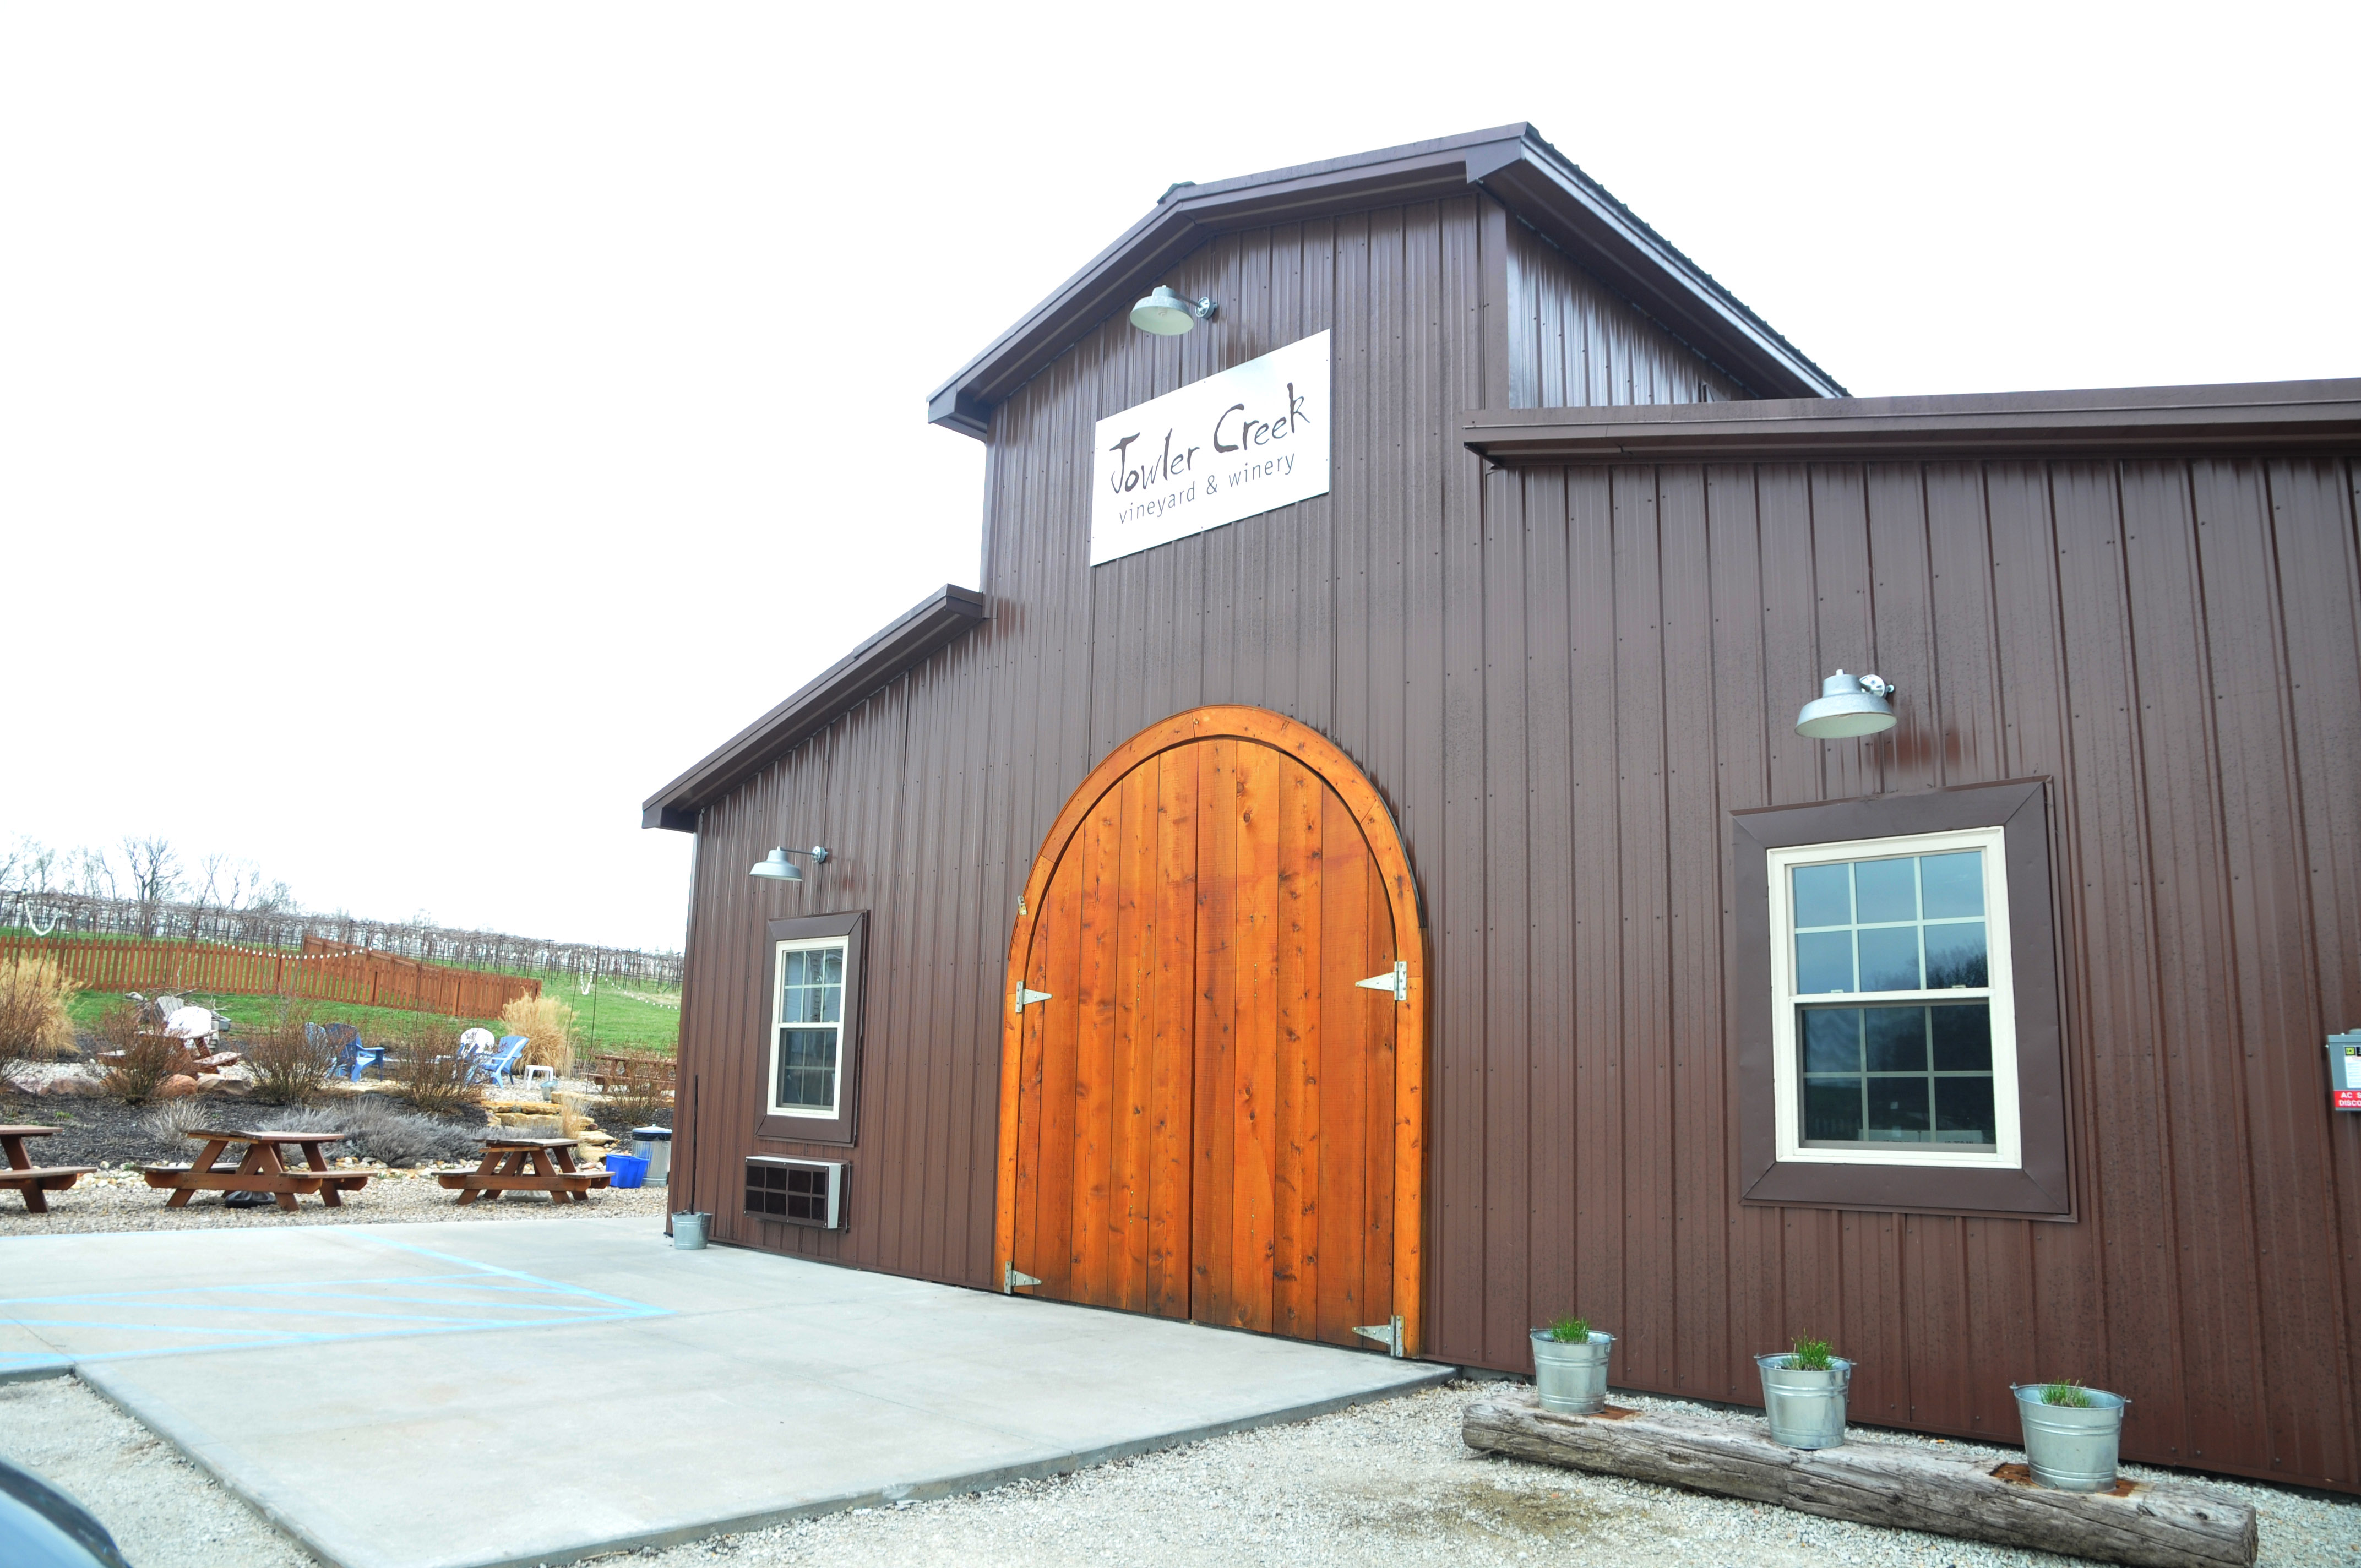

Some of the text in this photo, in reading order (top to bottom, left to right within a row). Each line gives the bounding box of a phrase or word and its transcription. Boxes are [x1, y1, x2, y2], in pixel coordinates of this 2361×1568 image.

[1109, 382, 1310, 494] Jowler Creek
[1119, 453, 1295, 524] vineyard & winery
